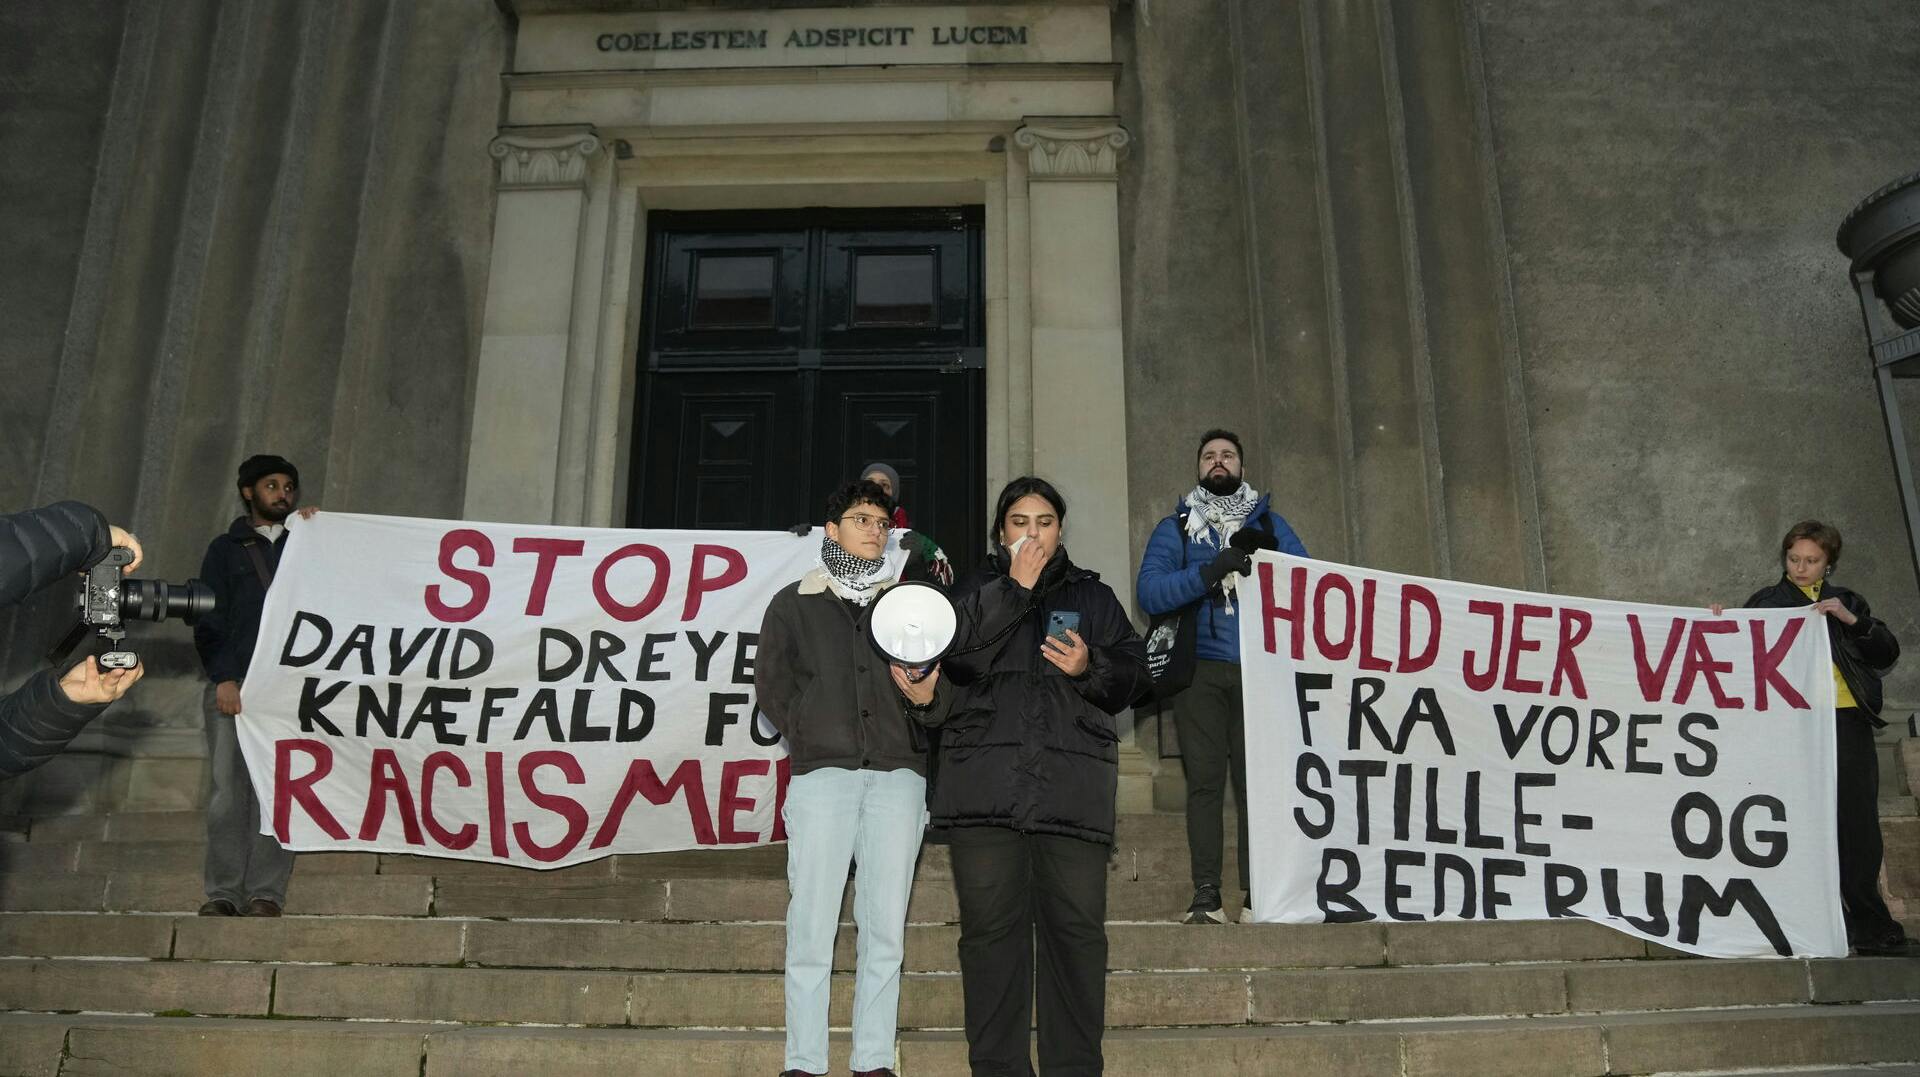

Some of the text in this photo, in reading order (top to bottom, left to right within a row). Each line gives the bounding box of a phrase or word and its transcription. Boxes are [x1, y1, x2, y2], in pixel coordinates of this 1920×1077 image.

[596, 26, 1028, 51] COELESTEM ADSPICIT LUCEM
[425, 529, 748, 622] STOP
[279, 610, 757, 683] DAVID DREYE
[1257, 562, 1810, 712] HOLD JER VÆK
[297, 676, 786, 747] KNÆFALD FO
[1294, 671, 1719, 778] FRA VORES
[1293, 751, 1789, 869] STILLE- OG
